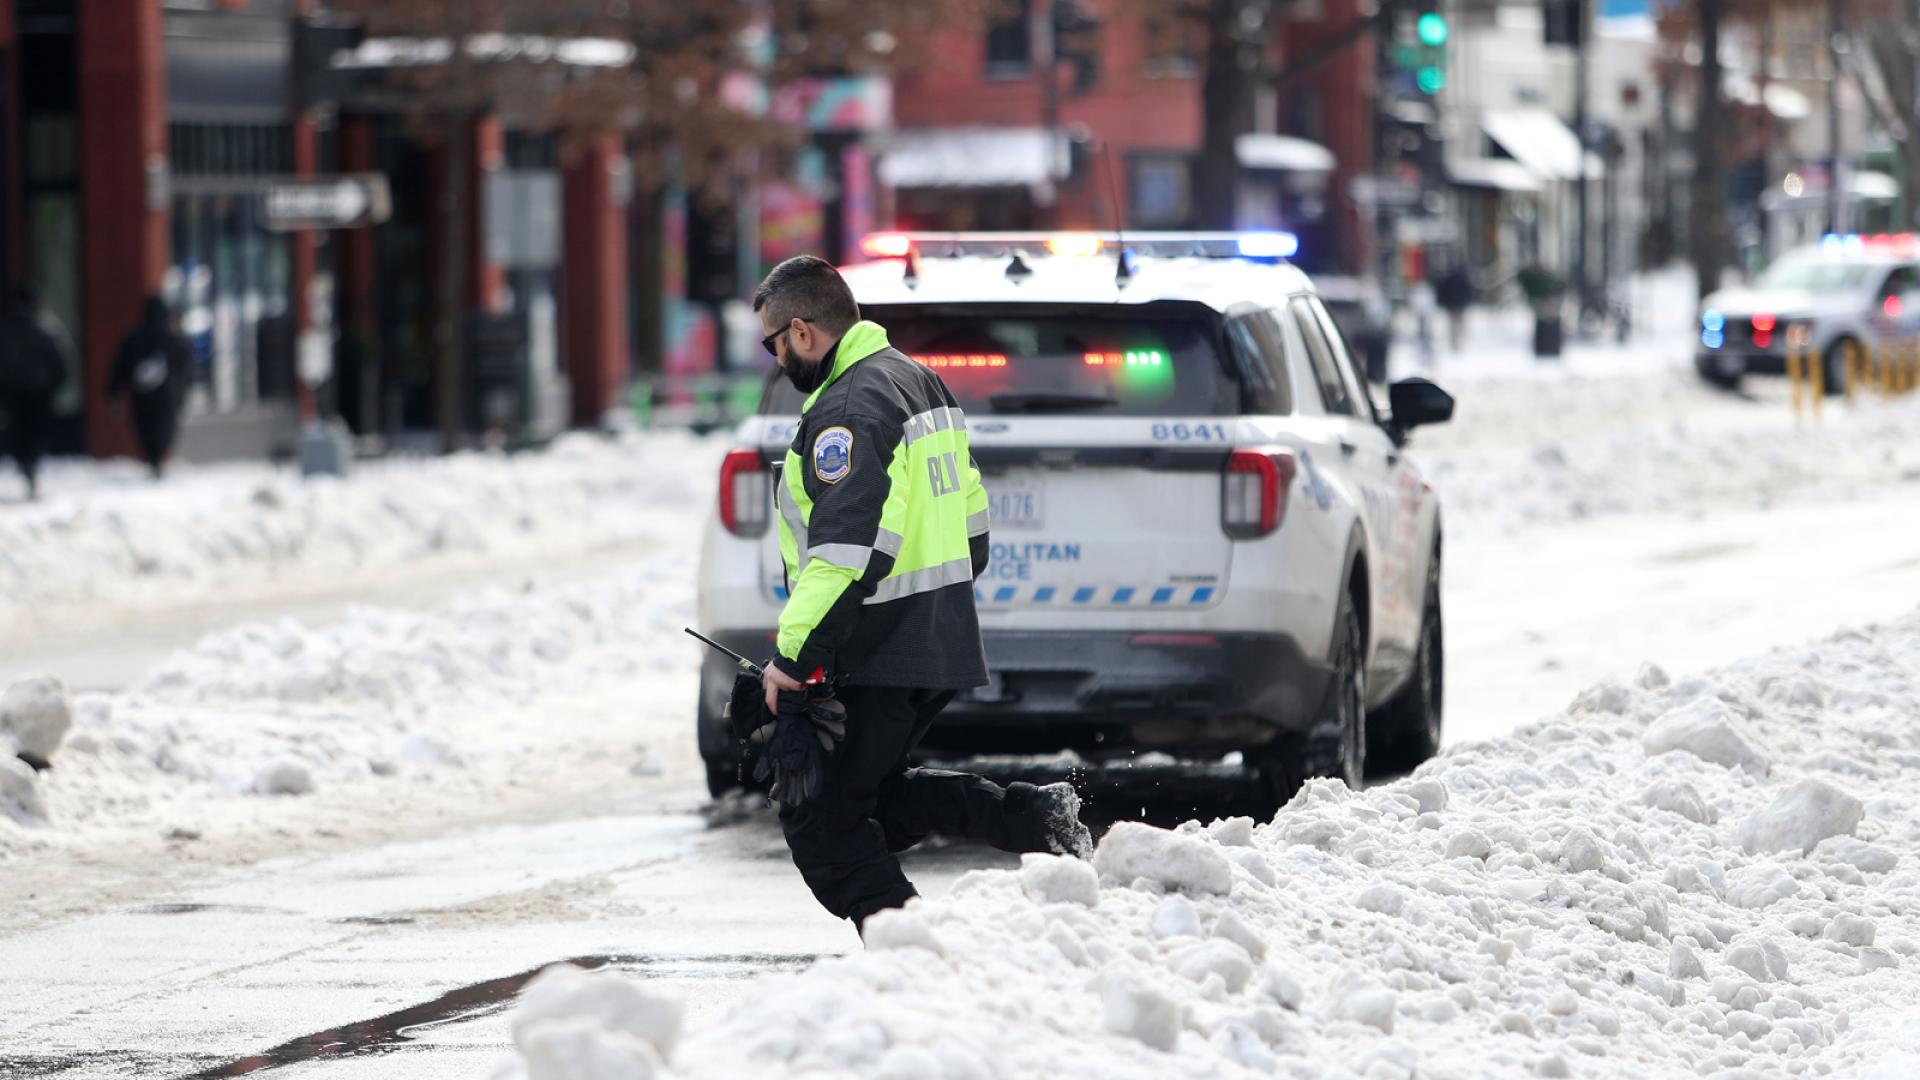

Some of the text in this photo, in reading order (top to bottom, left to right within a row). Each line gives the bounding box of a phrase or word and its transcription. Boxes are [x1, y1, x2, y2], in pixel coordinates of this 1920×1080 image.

[1152, 424, 1225, 441] 8641
[991, 543, 1081, 561] OLITAN
[981, 562, 1031, 580] ICE
